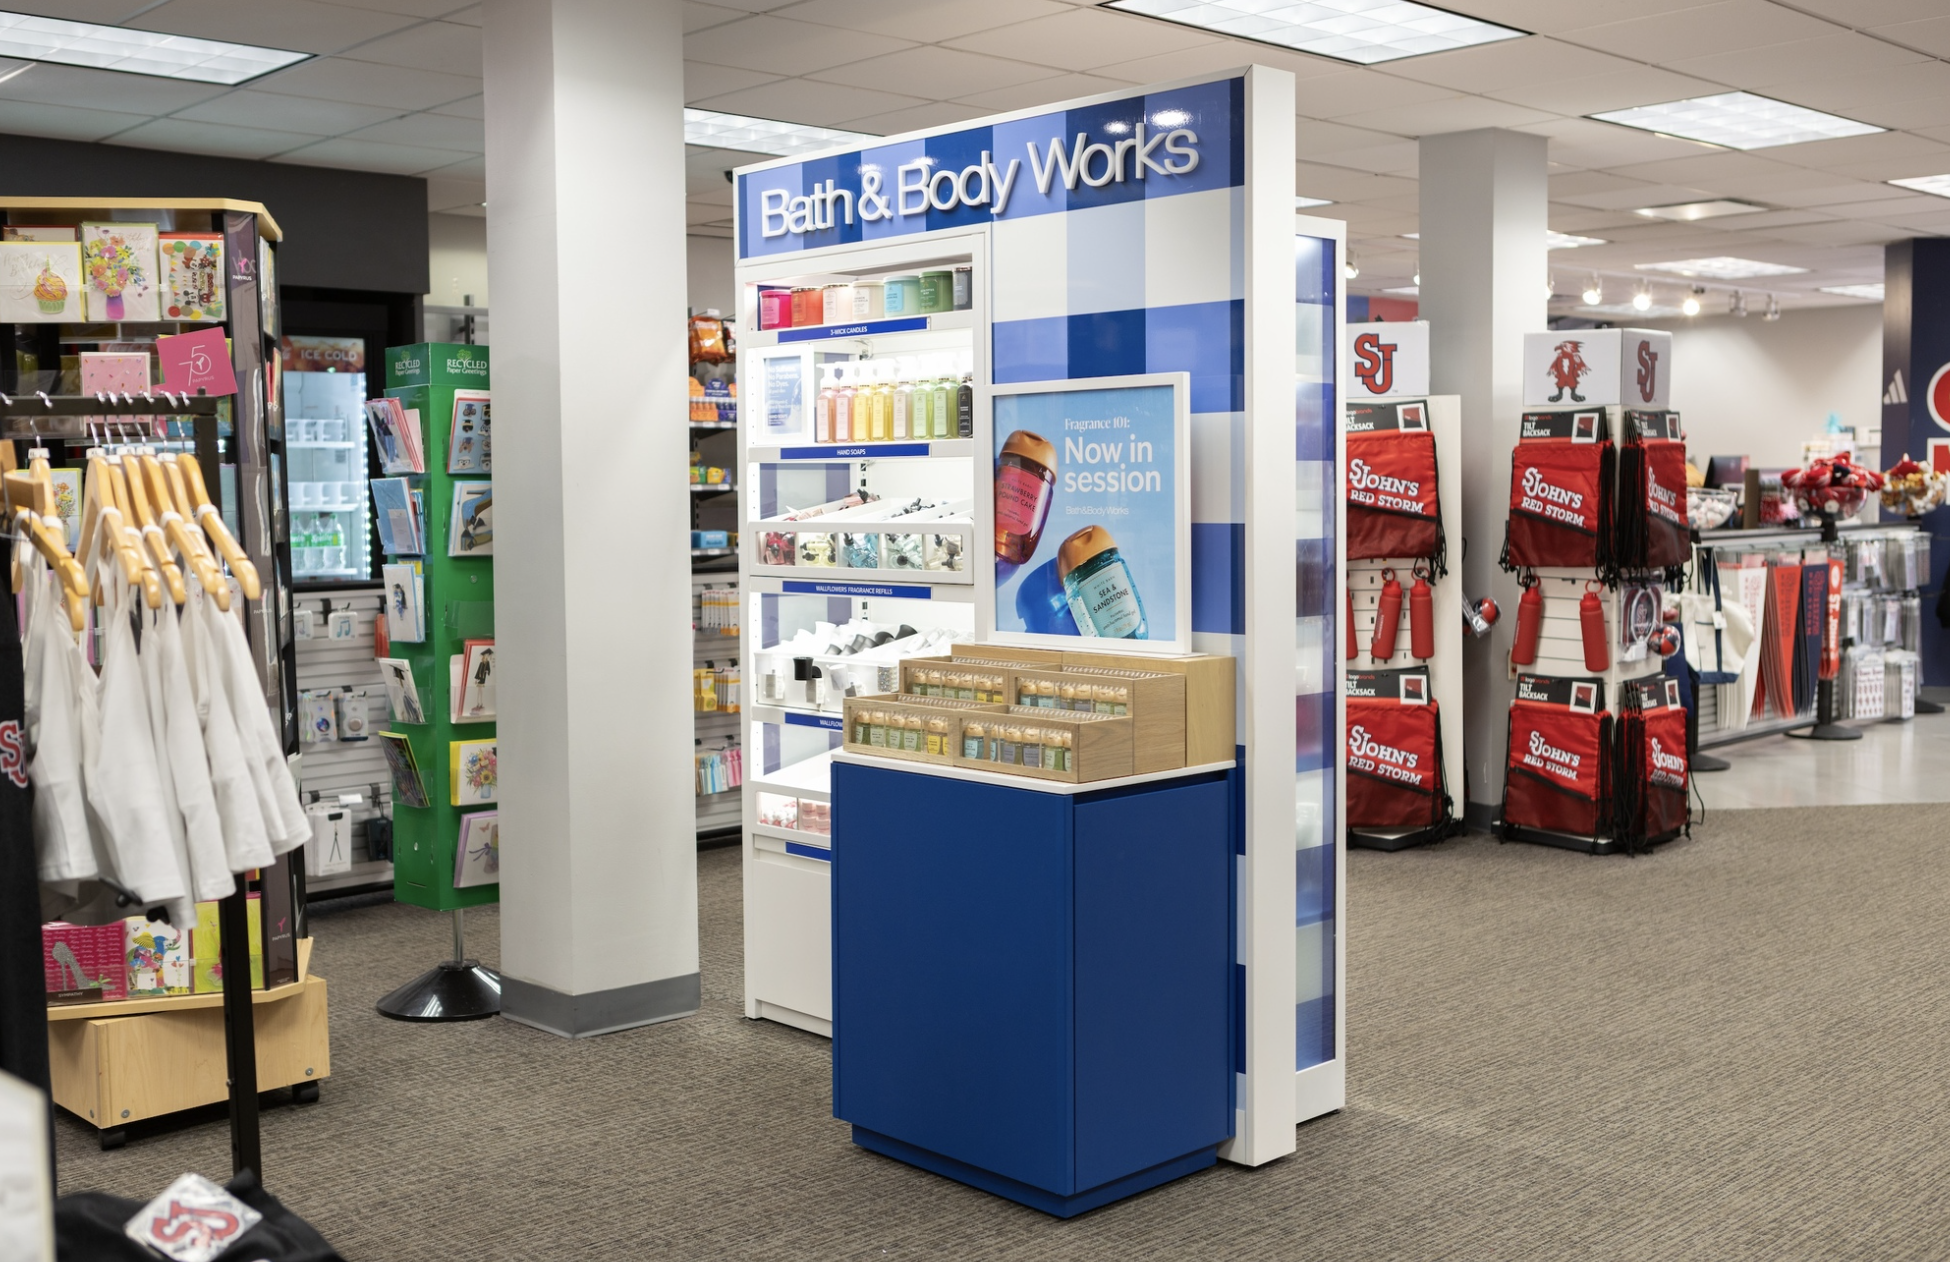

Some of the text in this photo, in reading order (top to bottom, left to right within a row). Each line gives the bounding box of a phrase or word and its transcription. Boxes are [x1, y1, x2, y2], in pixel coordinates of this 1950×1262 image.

[761, 122, 1199, 238] Bath & Body Works
[846, 326, 867, 334] CANDLES
[301, 350, 321, 360] ICE
[324, 350, 357, 361] COLD
[395, 359, 420, 369] RECYCLED
[447, 358, 487, 369] RECYCLED
[395, 369, 404, 377] Paper
[447, 367, 487, 376] Paper Greetings
[1065, 416, 1130, 433] Fragrance 101:
[1523, 422, 1536, 430] TILT
[1523, 428, 1551, 437] BACKSACK
[1065, 433, 1152, 464] Now in
[1065, 463, 1161, 493] session
[1001, 483, 1038, 503] STRAWBERRY
[1350, 489, 1375, 504] RED
[998, 490, 1036, 513] POUND CAKE
[1521, 496, 1543, 512] RED
[848, 586, 874, 594] FRAGRANCE
[1099, 583, 1117, 599] SEA &
[1093, 588, 1129, 614] SANDSTONE
[1829, 594, 1840, 614] ST.
[1520, 683, 1533, 692] TILT
[1519, 691, 1548, 701] BACKSACK
[1523, 753, 1544, 768] RED
[1348, 756, 1422, 785] RED STORM
